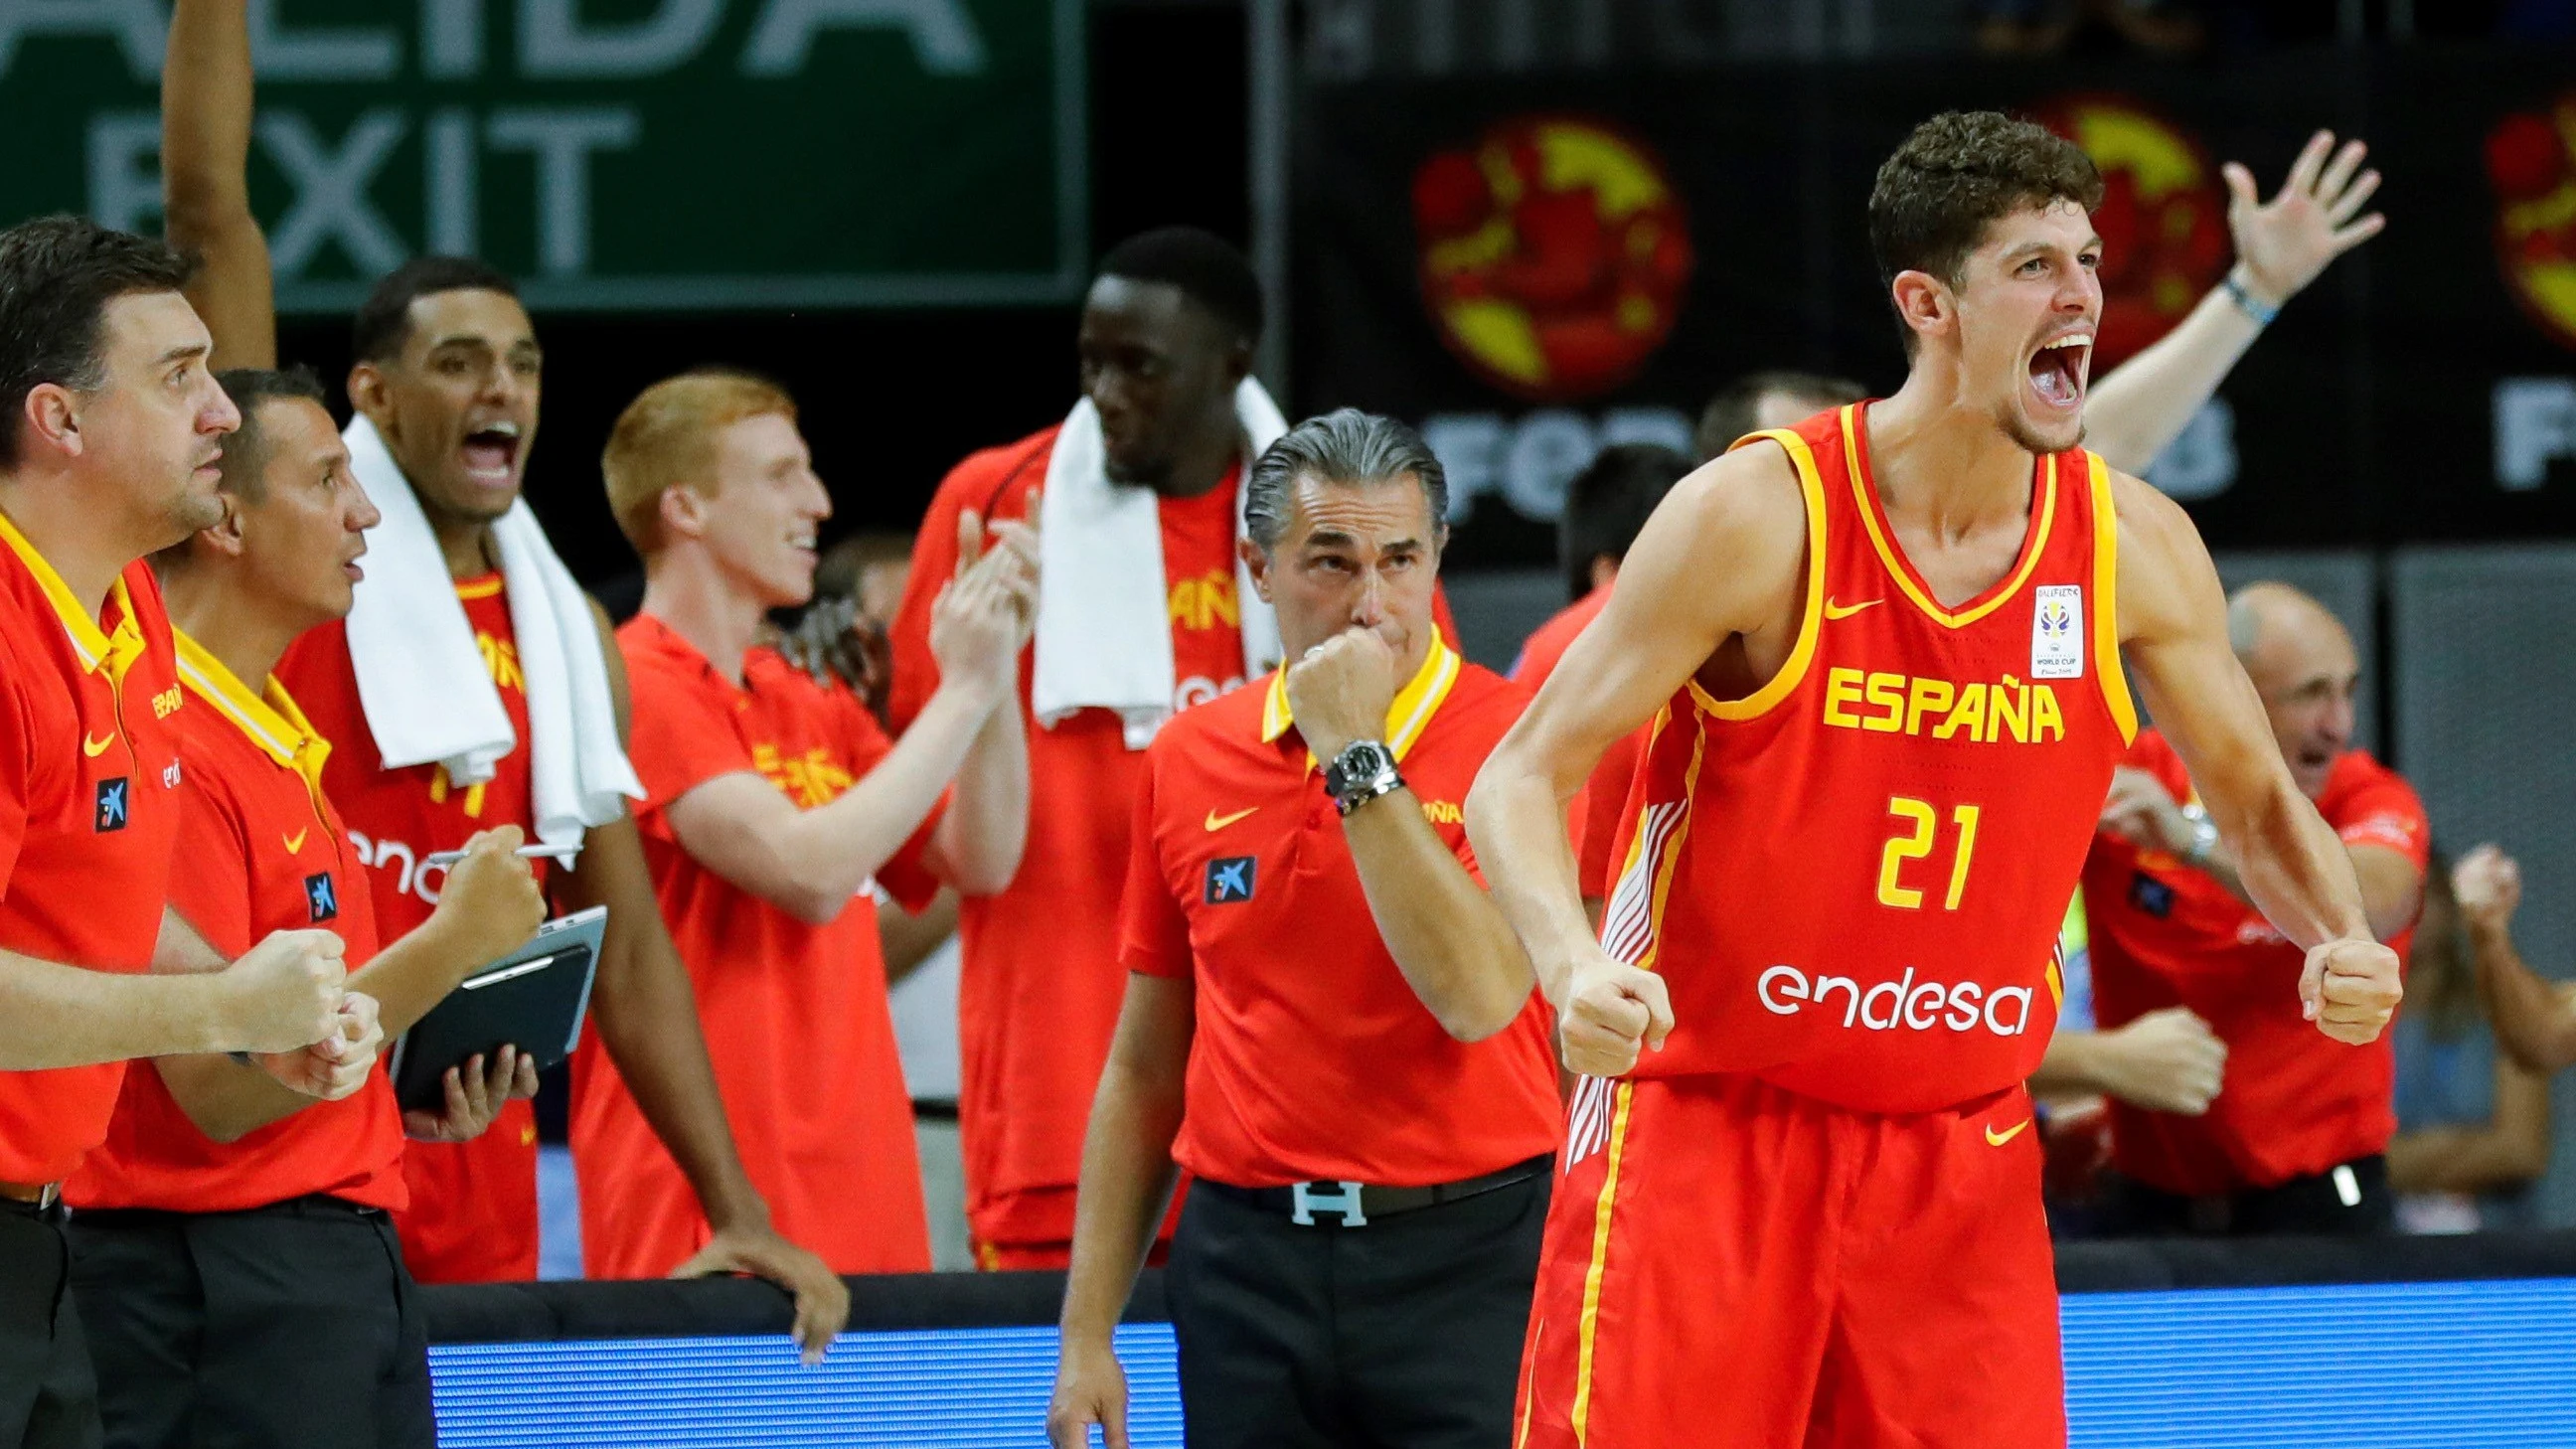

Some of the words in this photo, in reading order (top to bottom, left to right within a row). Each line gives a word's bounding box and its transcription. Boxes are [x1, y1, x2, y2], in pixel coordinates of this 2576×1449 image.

[87, 107, 641, 276] EXIT
[1823, 667, 2066, 743] ESPAÑA
[1877, 796, 1981, 911] 21
[1757, 965, 2033, 1037] endesa
